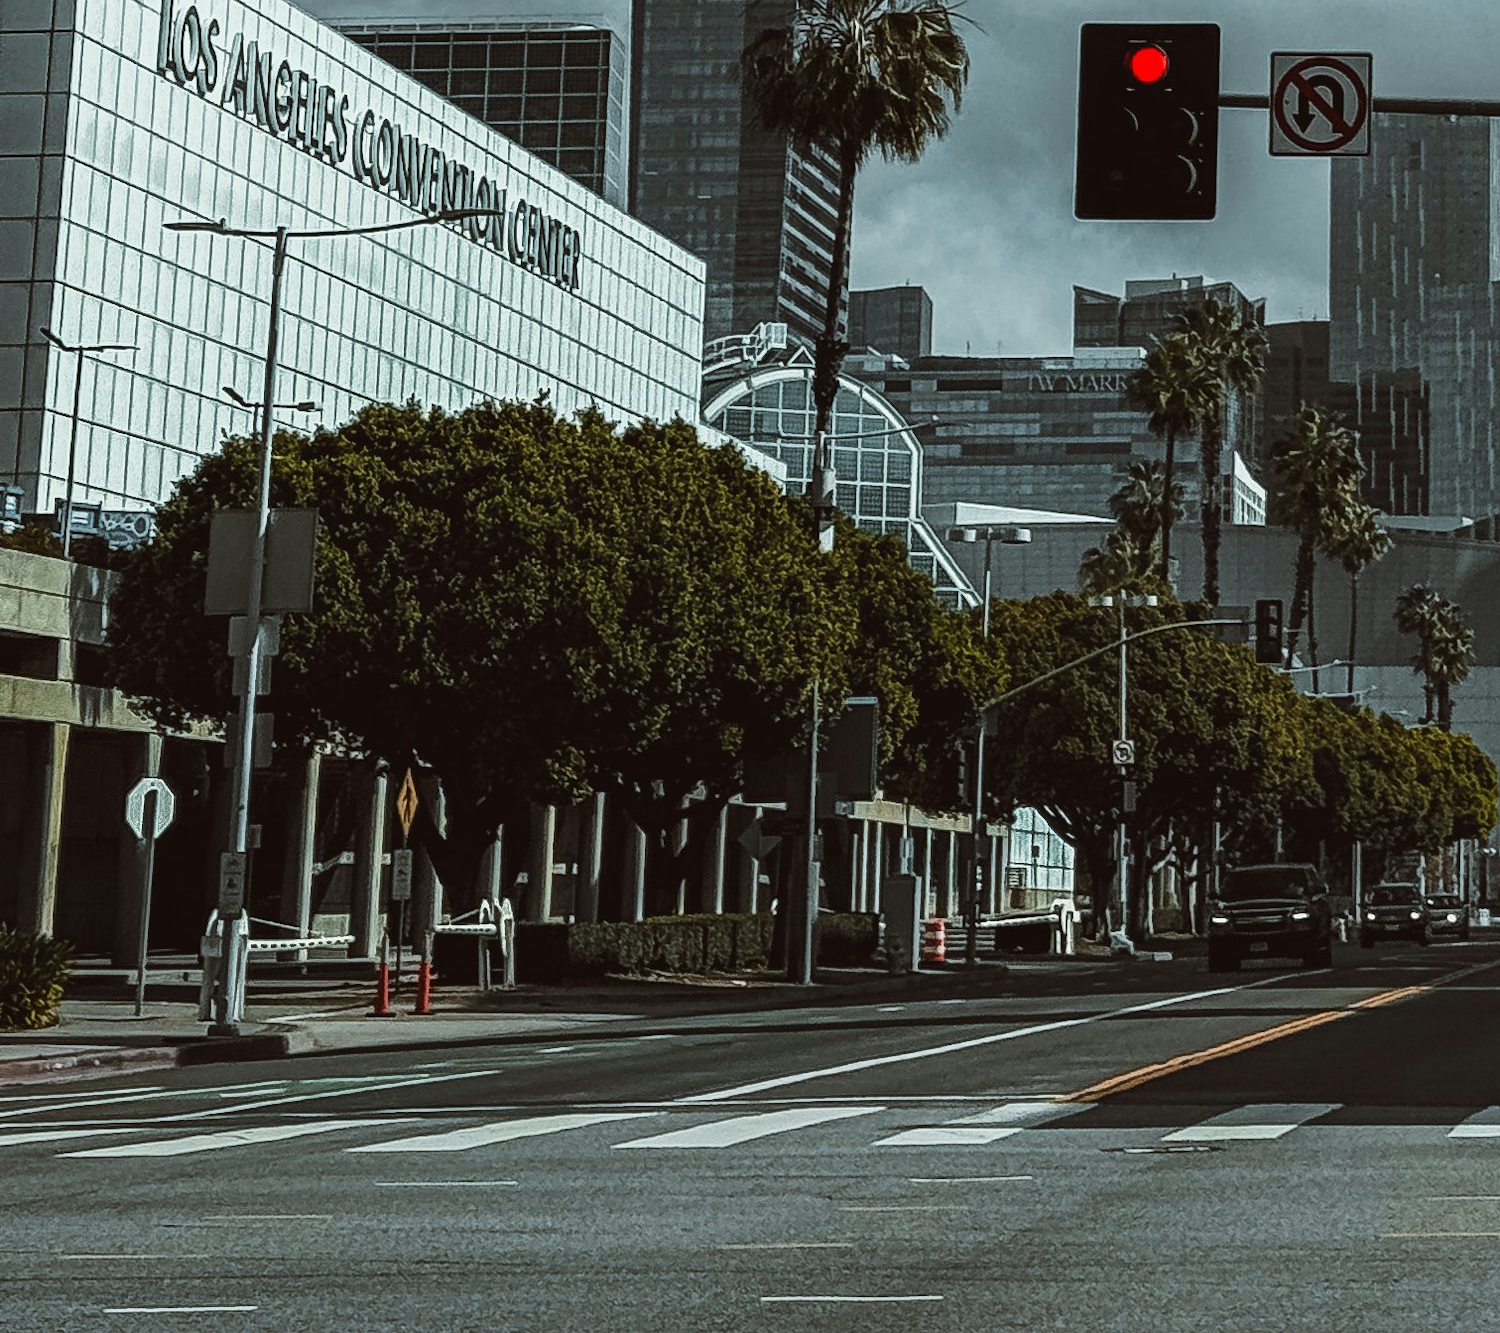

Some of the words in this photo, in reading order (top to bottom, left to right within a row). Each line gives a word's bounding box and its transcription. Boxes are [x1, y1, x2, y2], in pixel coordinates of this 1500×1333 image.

[222, 32, 349, 166] ANGELES
[352, 109, 507, 252] CONVENTION
[508, 199, 581, 292] CENTER
